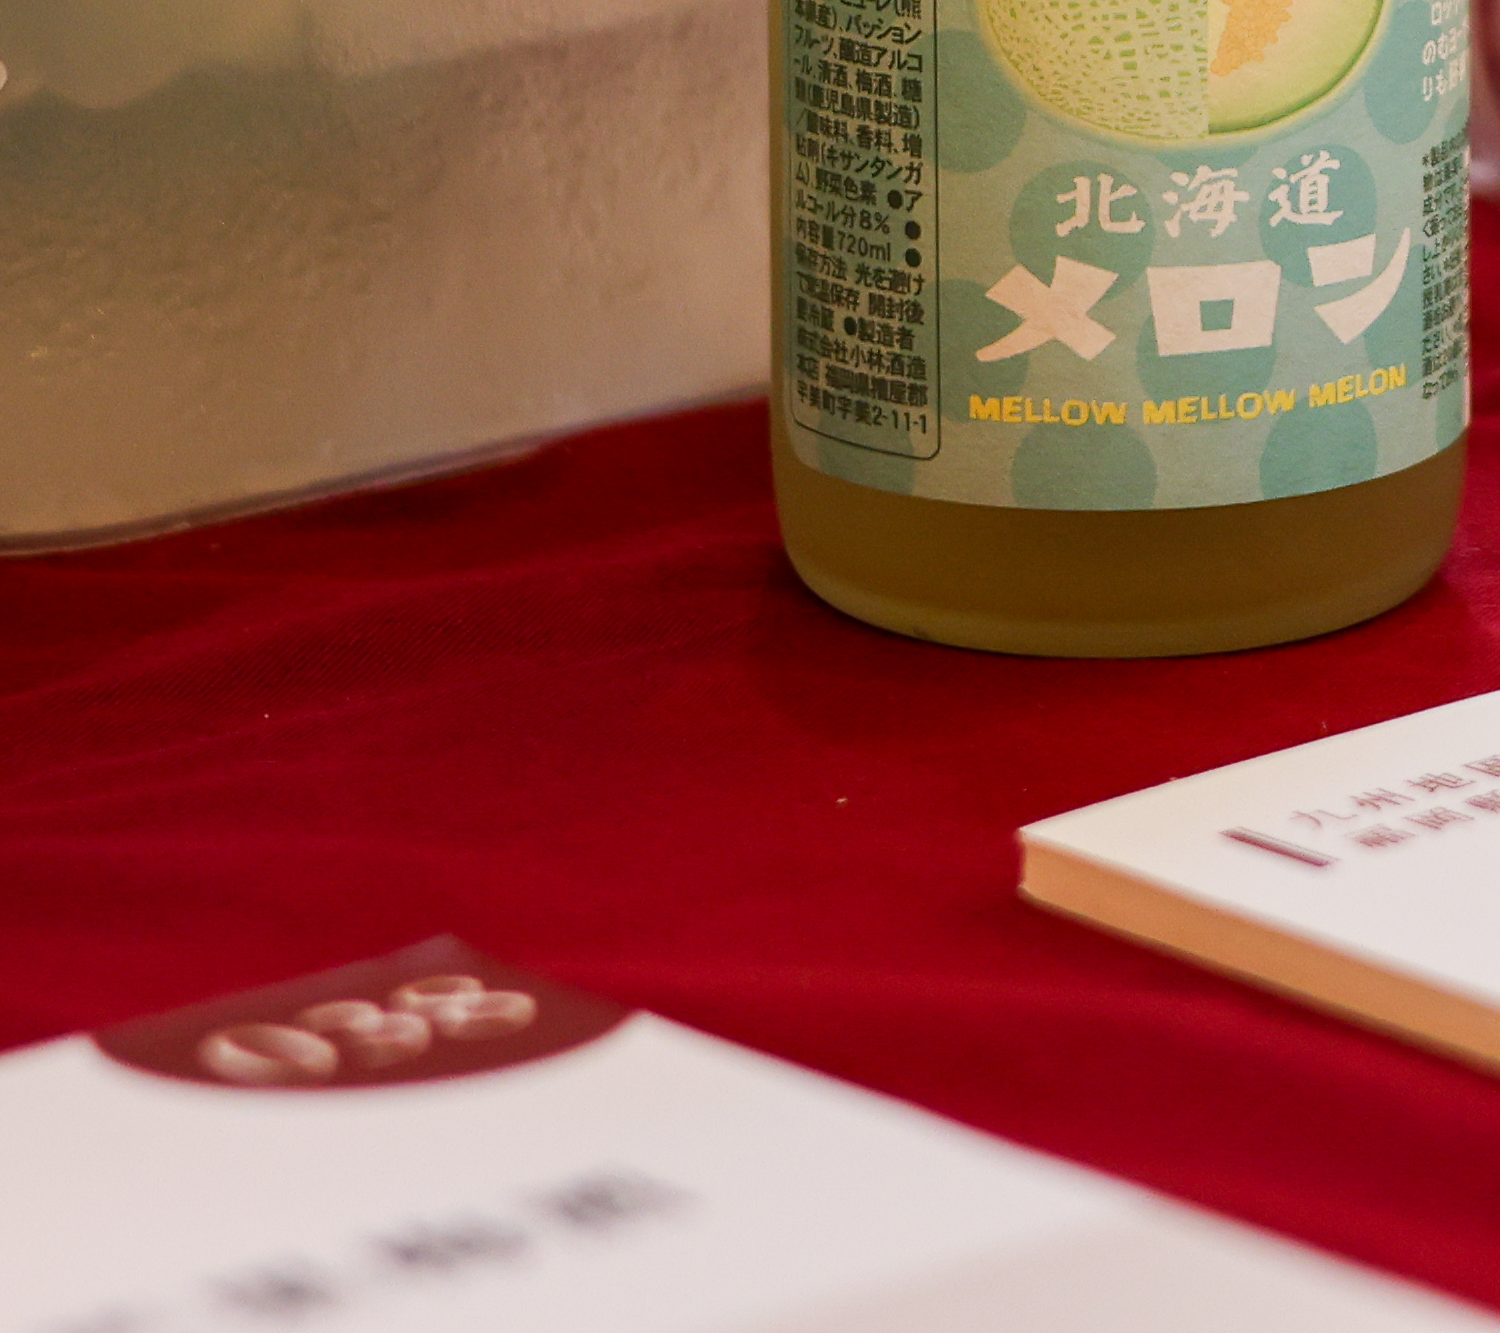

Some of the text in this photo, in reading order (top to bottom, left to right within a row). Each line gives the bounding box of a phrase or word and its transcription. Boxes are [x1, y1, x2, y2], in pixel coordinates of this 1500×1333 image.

[1055, 149, 1344, 238] 北海道
[975, 227, 1412, 363] メロン
[968, 363, 1407, 427] MELLOW MELLOW MELON
[199, 971, 538, 1088] 038
